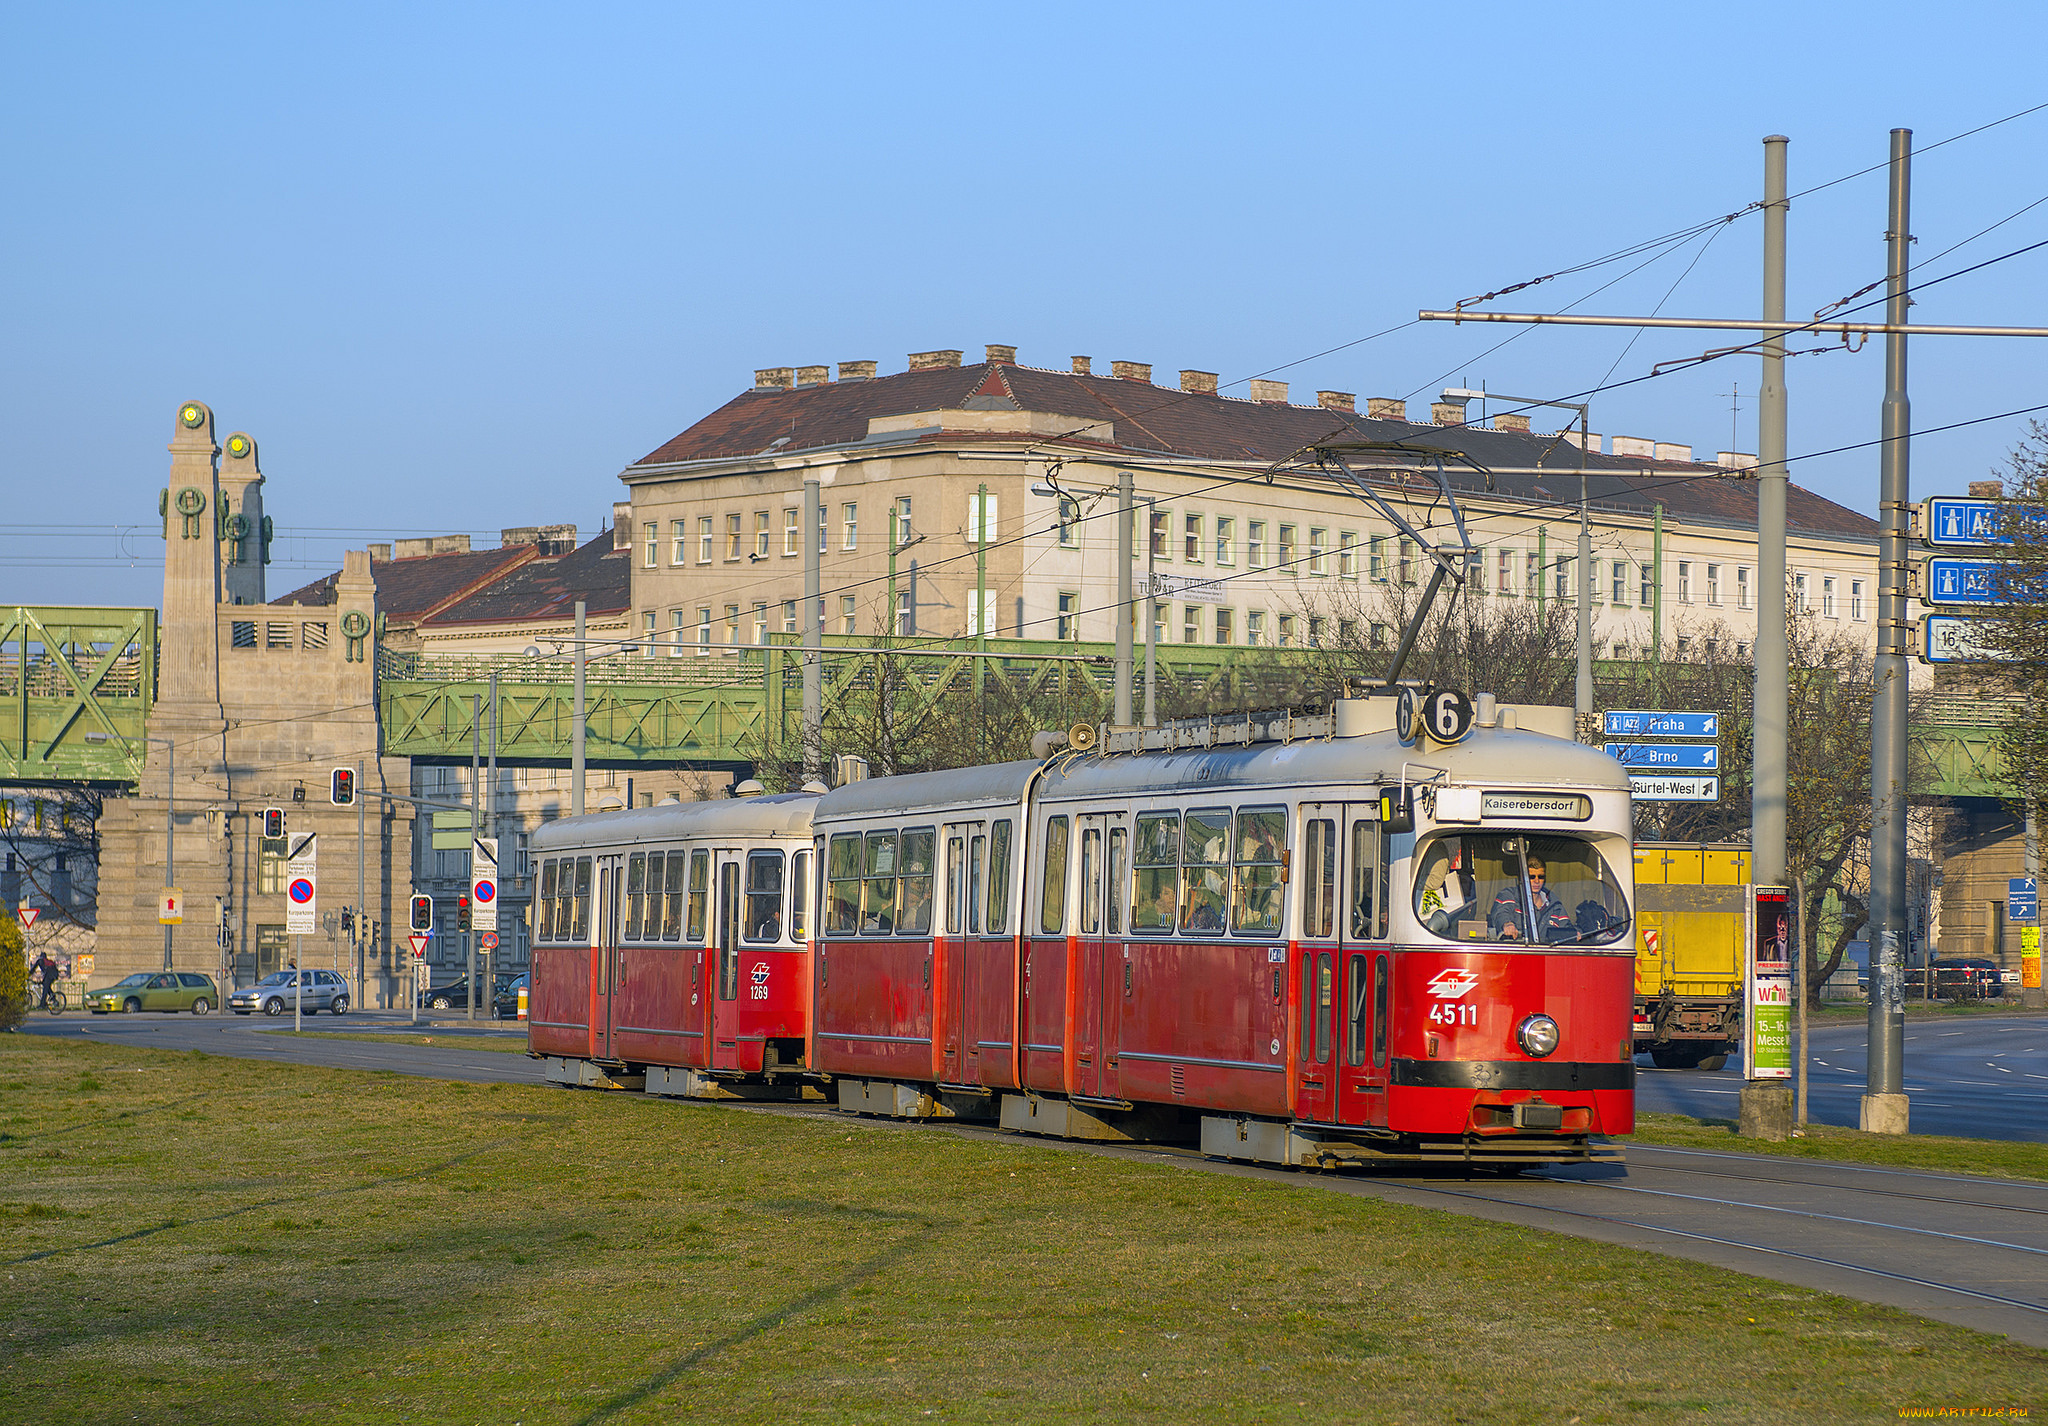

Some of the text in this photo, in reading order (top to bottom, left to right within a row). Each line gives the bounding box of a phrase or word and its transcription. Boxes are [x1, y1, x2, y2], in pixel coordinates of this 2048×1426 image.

[1966, 573, 1987, 591] A2
[1941, 630, 1956, 647] 16
[1400, 692, 1409, 735] 6
[1436, 692, 1459, 736] 6
[1624, 717, 1685, 731] A22 Praha
[1649, 749, 1679, 763] Brno
[1633, 780, 1696, 795] Gürtel-West
[1484, 798, 1574, 811] Kaiserebersdorf
[750, 985, 768, 1000] 1269
[1429, 1003, 1477, 1026] 4511
[1757, 1034, 1785, 1046] Messe
